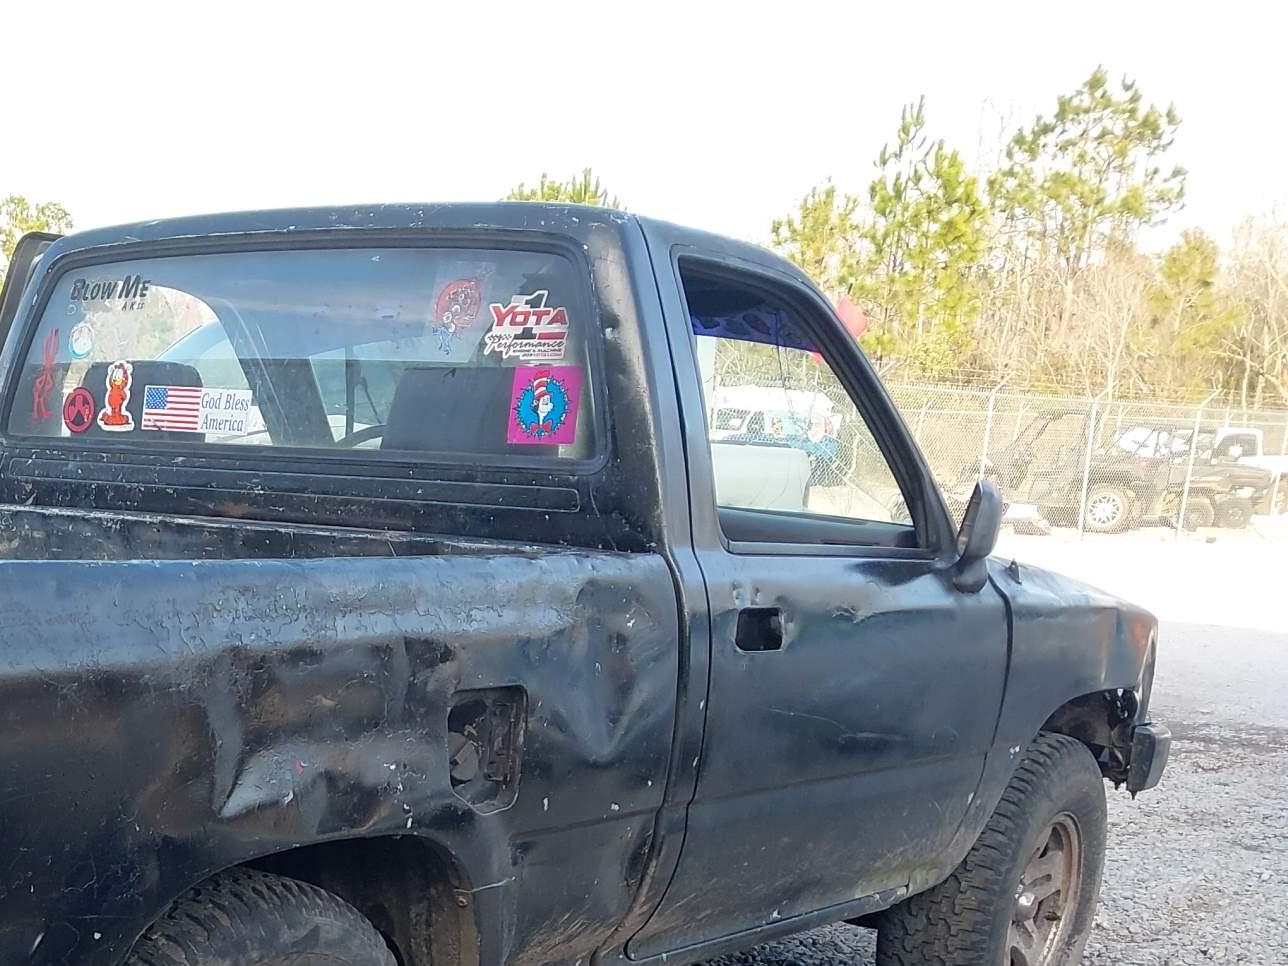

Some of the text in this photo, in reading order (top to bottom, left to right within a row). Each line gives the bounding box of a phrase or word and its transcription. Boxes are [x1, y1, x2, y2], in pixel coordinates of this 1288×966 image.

[491, 305, 568, 327] YOTA
[487, 333, 565, 355] Performance
[201, 393, 250, 411] God Bless
[200, 413, 244, 432] America
